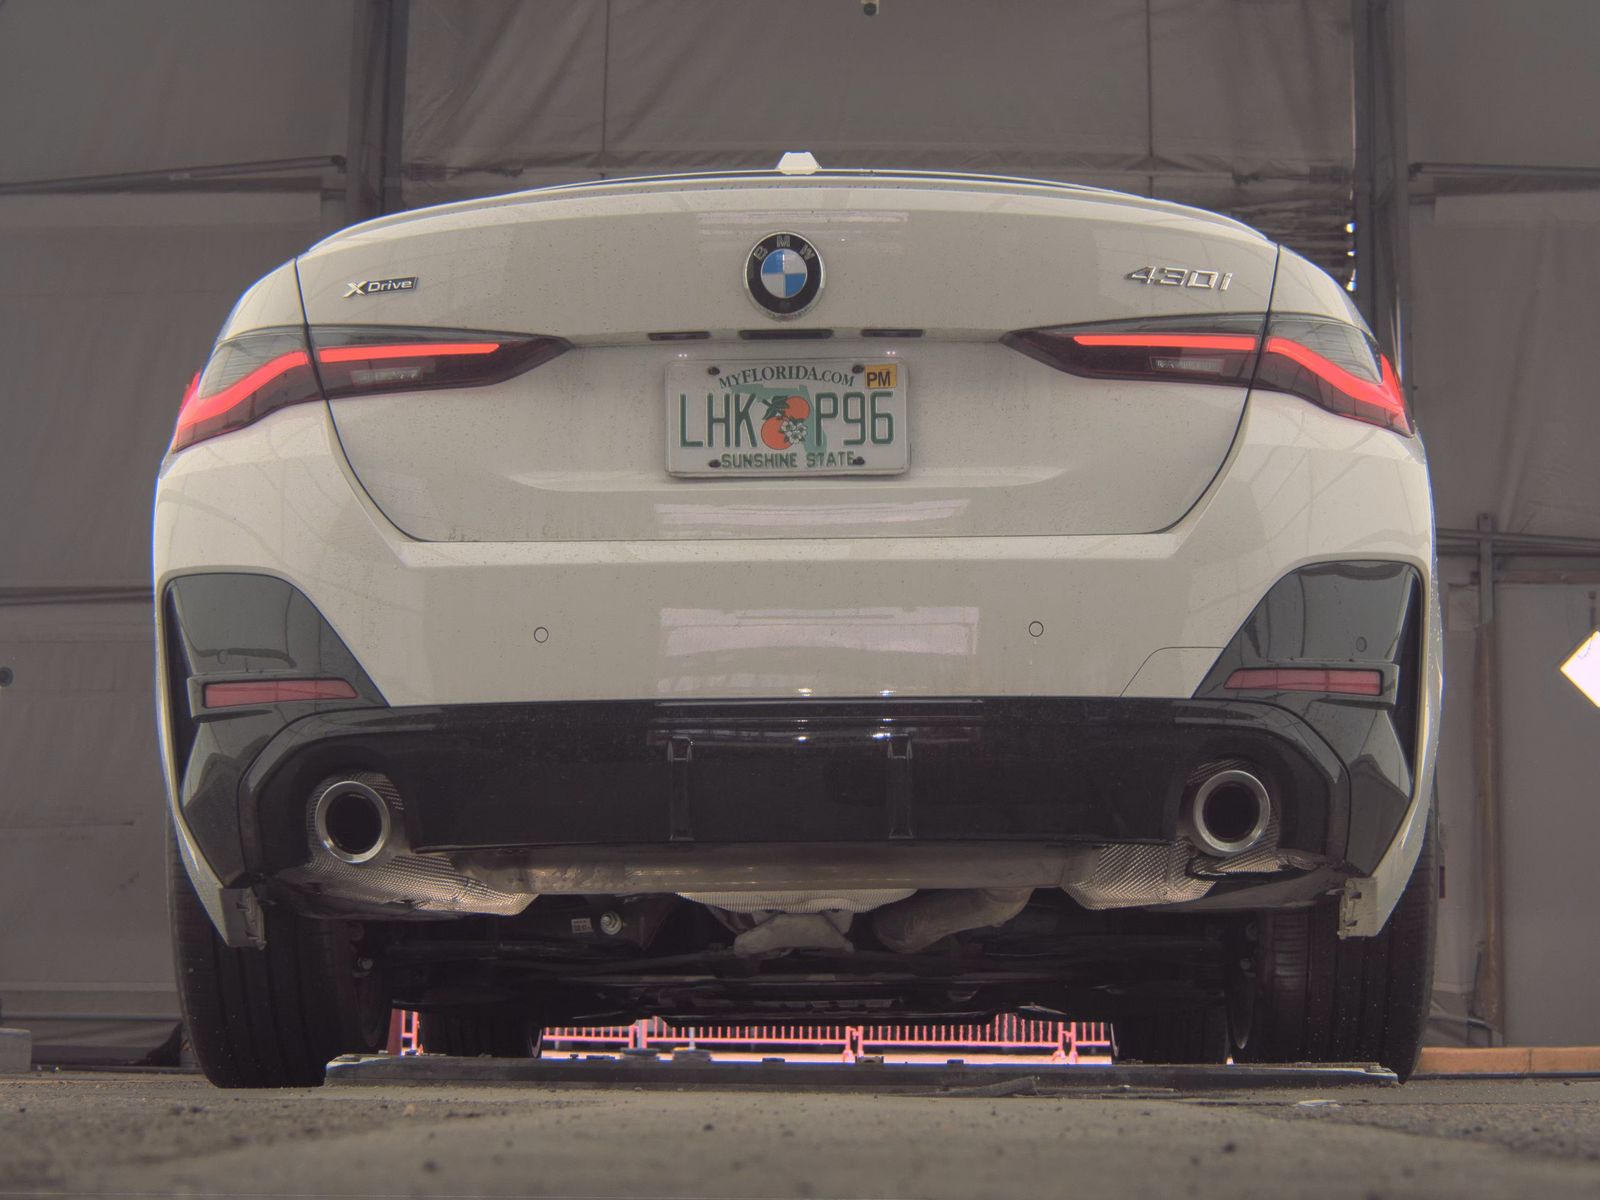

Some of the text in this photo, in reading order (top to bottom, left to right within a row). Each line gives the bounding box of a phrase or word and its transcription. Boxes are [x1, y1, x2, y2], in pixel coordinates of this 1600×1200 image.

[753, 235, 816, 261] BMW
[1125, 265, 1233, 291] 430i
[718, 365, 856, 389] MYFLORIDA.COM
[866, 371, 891, 387] PM
[680, 391, 895, 448] LHK P96
[721, 451, 855, 469] SUNSHINE STATE
